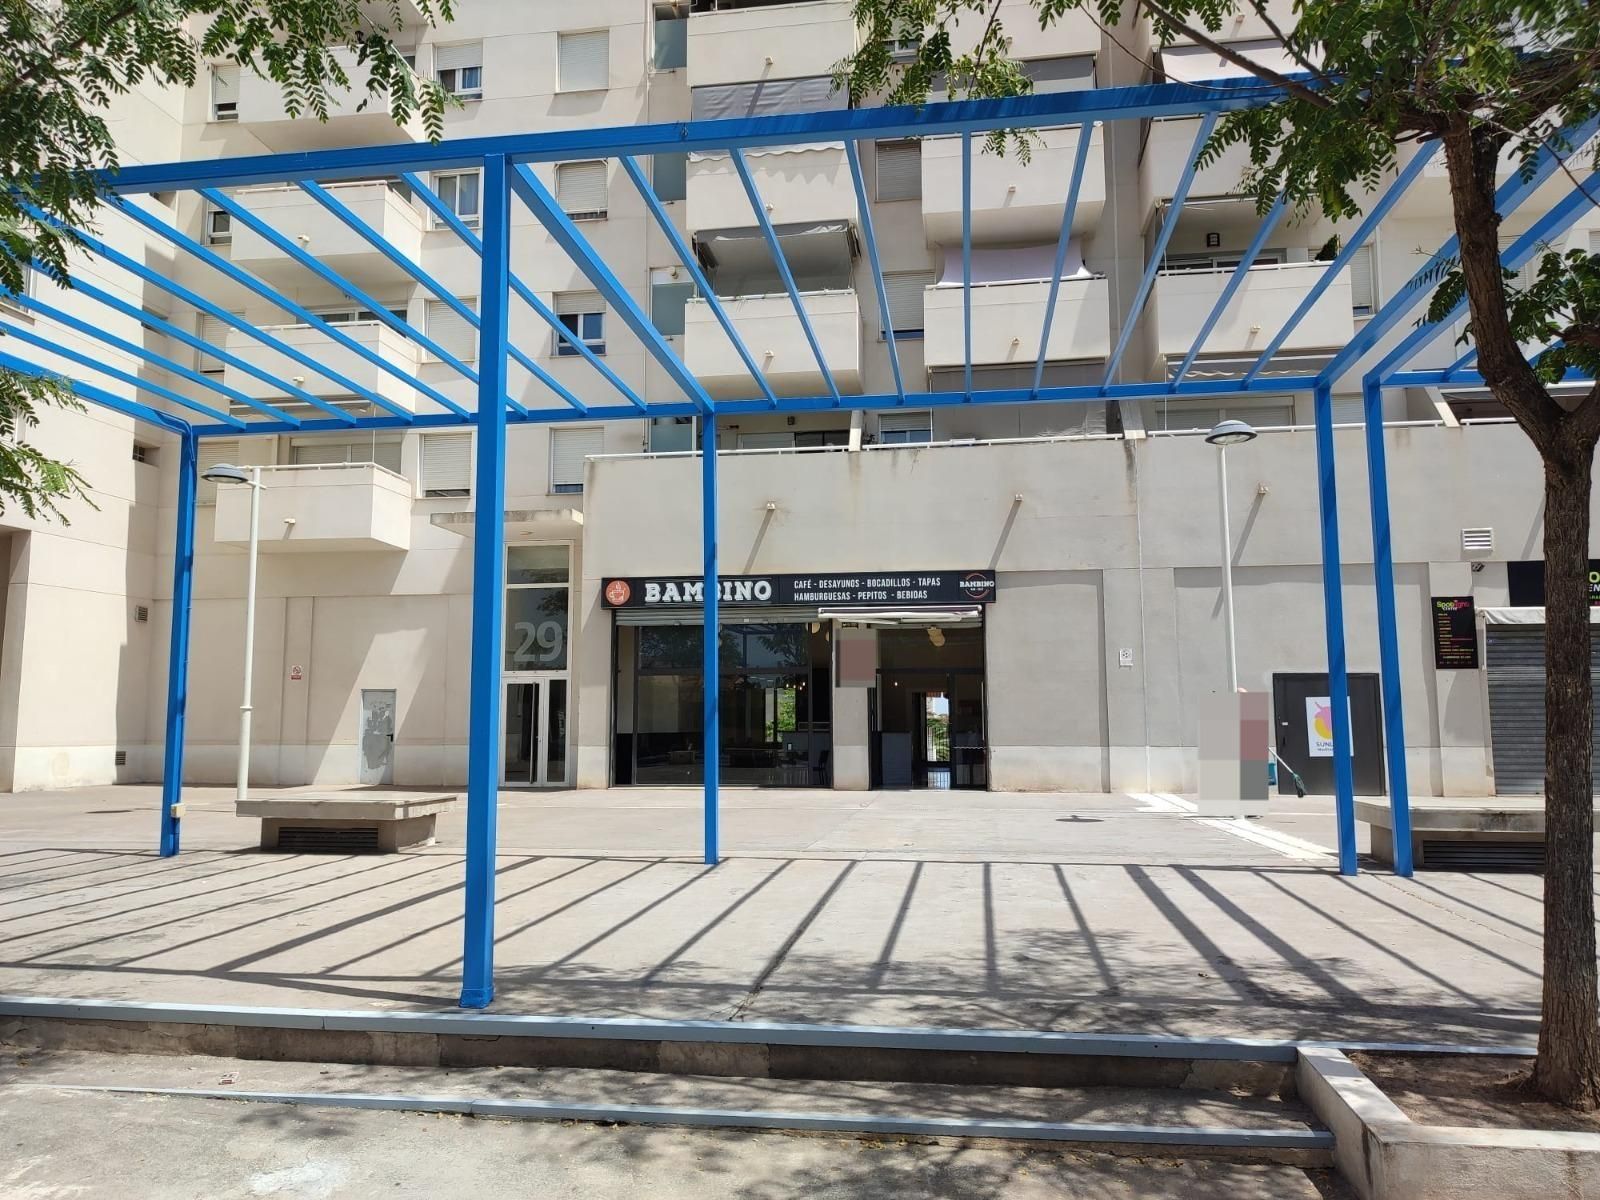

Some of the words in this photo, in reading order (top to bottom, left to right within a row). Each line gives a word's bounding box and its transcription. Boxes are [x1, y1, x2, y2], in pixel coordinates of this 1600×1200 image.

[794, 579, 812, 589] CAFÉ
[819, 579, 860, 589] DESAYUNOS
[866, 578, 911, 588] BOCADILLOS
[918, 577, 941, 587] TAPAS
[959, 580, 995, 588] BAMBINO
[644, 580, 772, 603] BAMINO
[794, 591, 851, 601] HAMBURGUESAS
[857, 591, 888, 600] PEPITOS
[896, 590, 928, 600] BEBIDAS
[514, 621, 563, 662] 29
